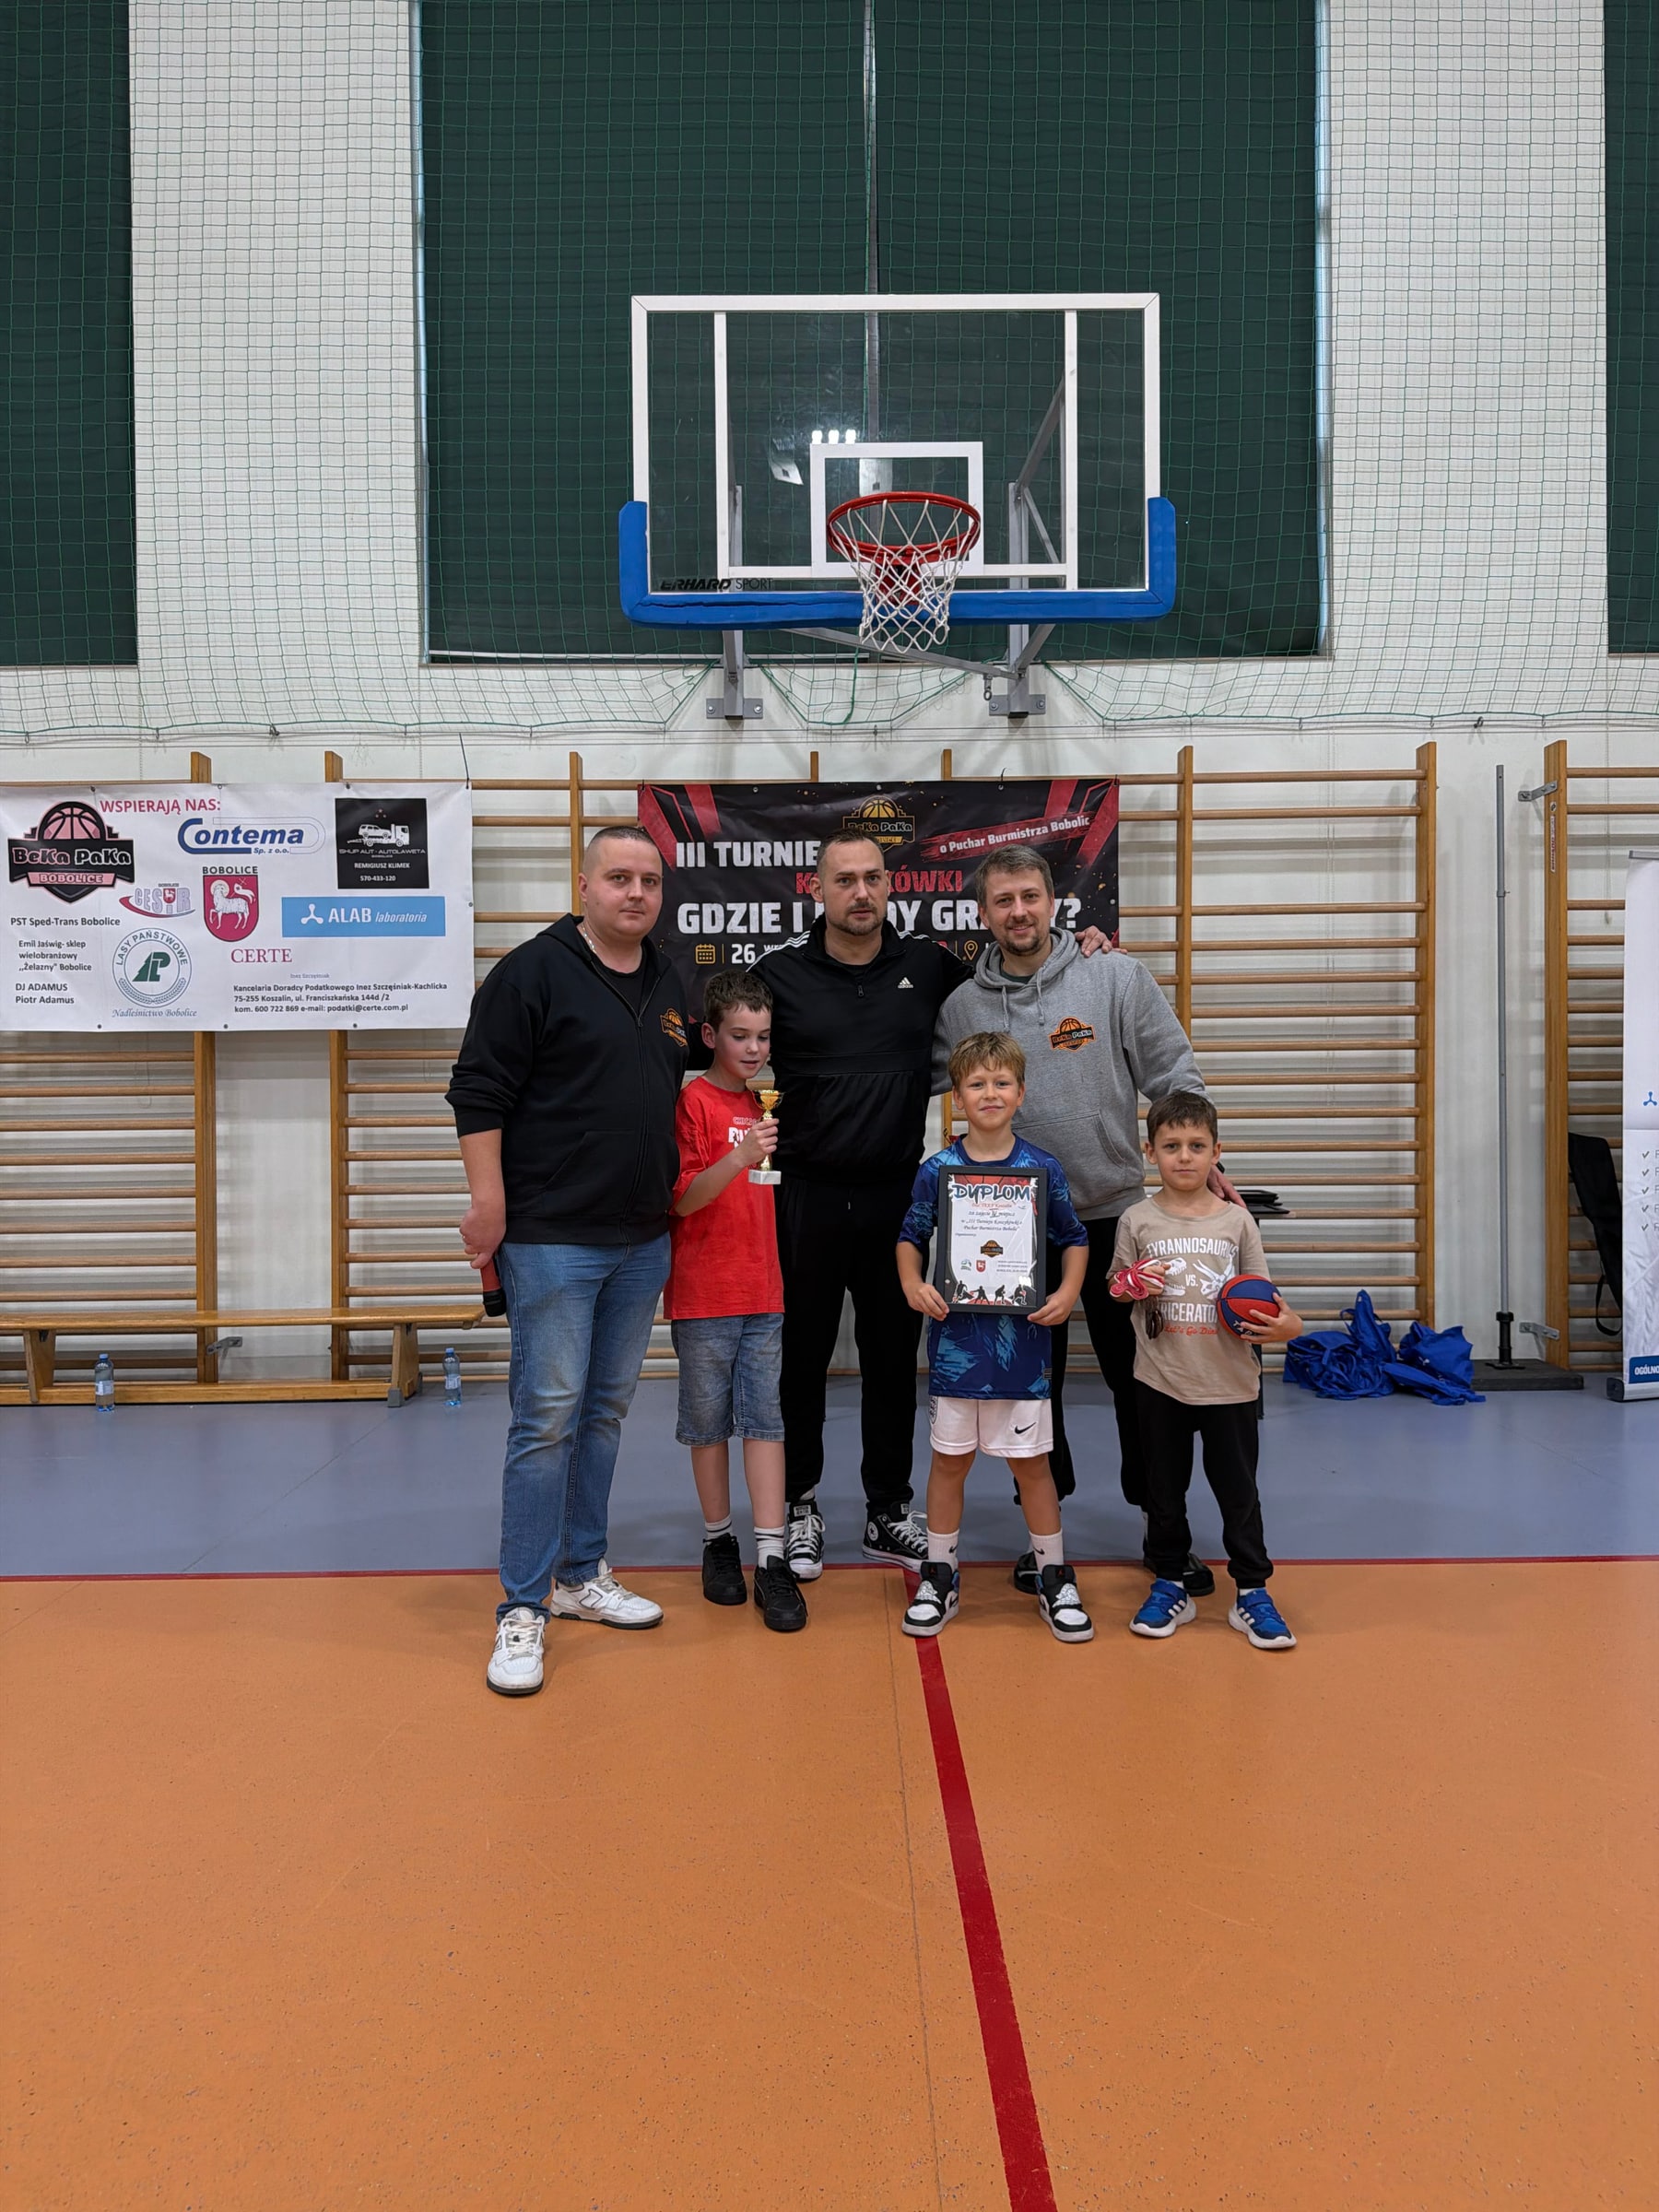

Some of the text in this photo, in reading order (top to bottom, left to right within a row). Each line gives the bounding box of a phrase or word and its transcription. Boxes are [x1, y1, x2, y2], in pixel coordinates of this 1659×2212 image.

[660, 578, 773, 590] ERHARD SPORT
[100, 798, 221, 815] WSPIERAJĄ NAS:
[880, 821, 913, 832] PaKa
[178, 818, 304, 854] Contema
[939, 816, 1090, 853] o Puchar Burmistrza Bobolic
[13, 847, 132, 865] BeKa PaKa
[676, 841, 821, 868] III TURNIE
[202, 866, 259, 875] BOBOLICE
[39, 873, 103, 884] BOBOLICE
[328, 907, 428, 924] ALAB laboratoria
[677, 901, 782, 935] GDZIE
[793, 901, 803, 934] I
[10, 917, 121, 928] PST Sped-Trans Bobolice
[18, 939, 35, 948] Emil
[66, 939, 87, 950] sklep
[116, 930, 188, 966] LASY PAŃSTWOWE
[18, 951, 78, 962] wielobranżowy
[230, 948, 293, 963] CERTE
[731, 943, 756, 964] 26
[60, 963, 92, 971] Bobolice
[16, 983, 68, 993] DJ ADAMUS
[273, 984, 303, 993] Doradcy
[305, 983, 355, 993] Podatkowego
[372, 982, 448, 992] Szczęśniak-Kachlicka
[16, 995, 75, 1005] Piotr Adamus
[261, 994, 293, 1003] Koszalin,
[306, 994, 359, 1002] Franciszkańska
[112, 1007, 197, 1018] Nadleśnictwo Bobolice
[326, 1004, 408, 1013] podatki@certe.com.pl
[952, 1184, 1030, 1204] DYPLOM
[1184, 1274, 1199, 1287] VS.
[1159, 1302, 1218, 1324] RICERATO
